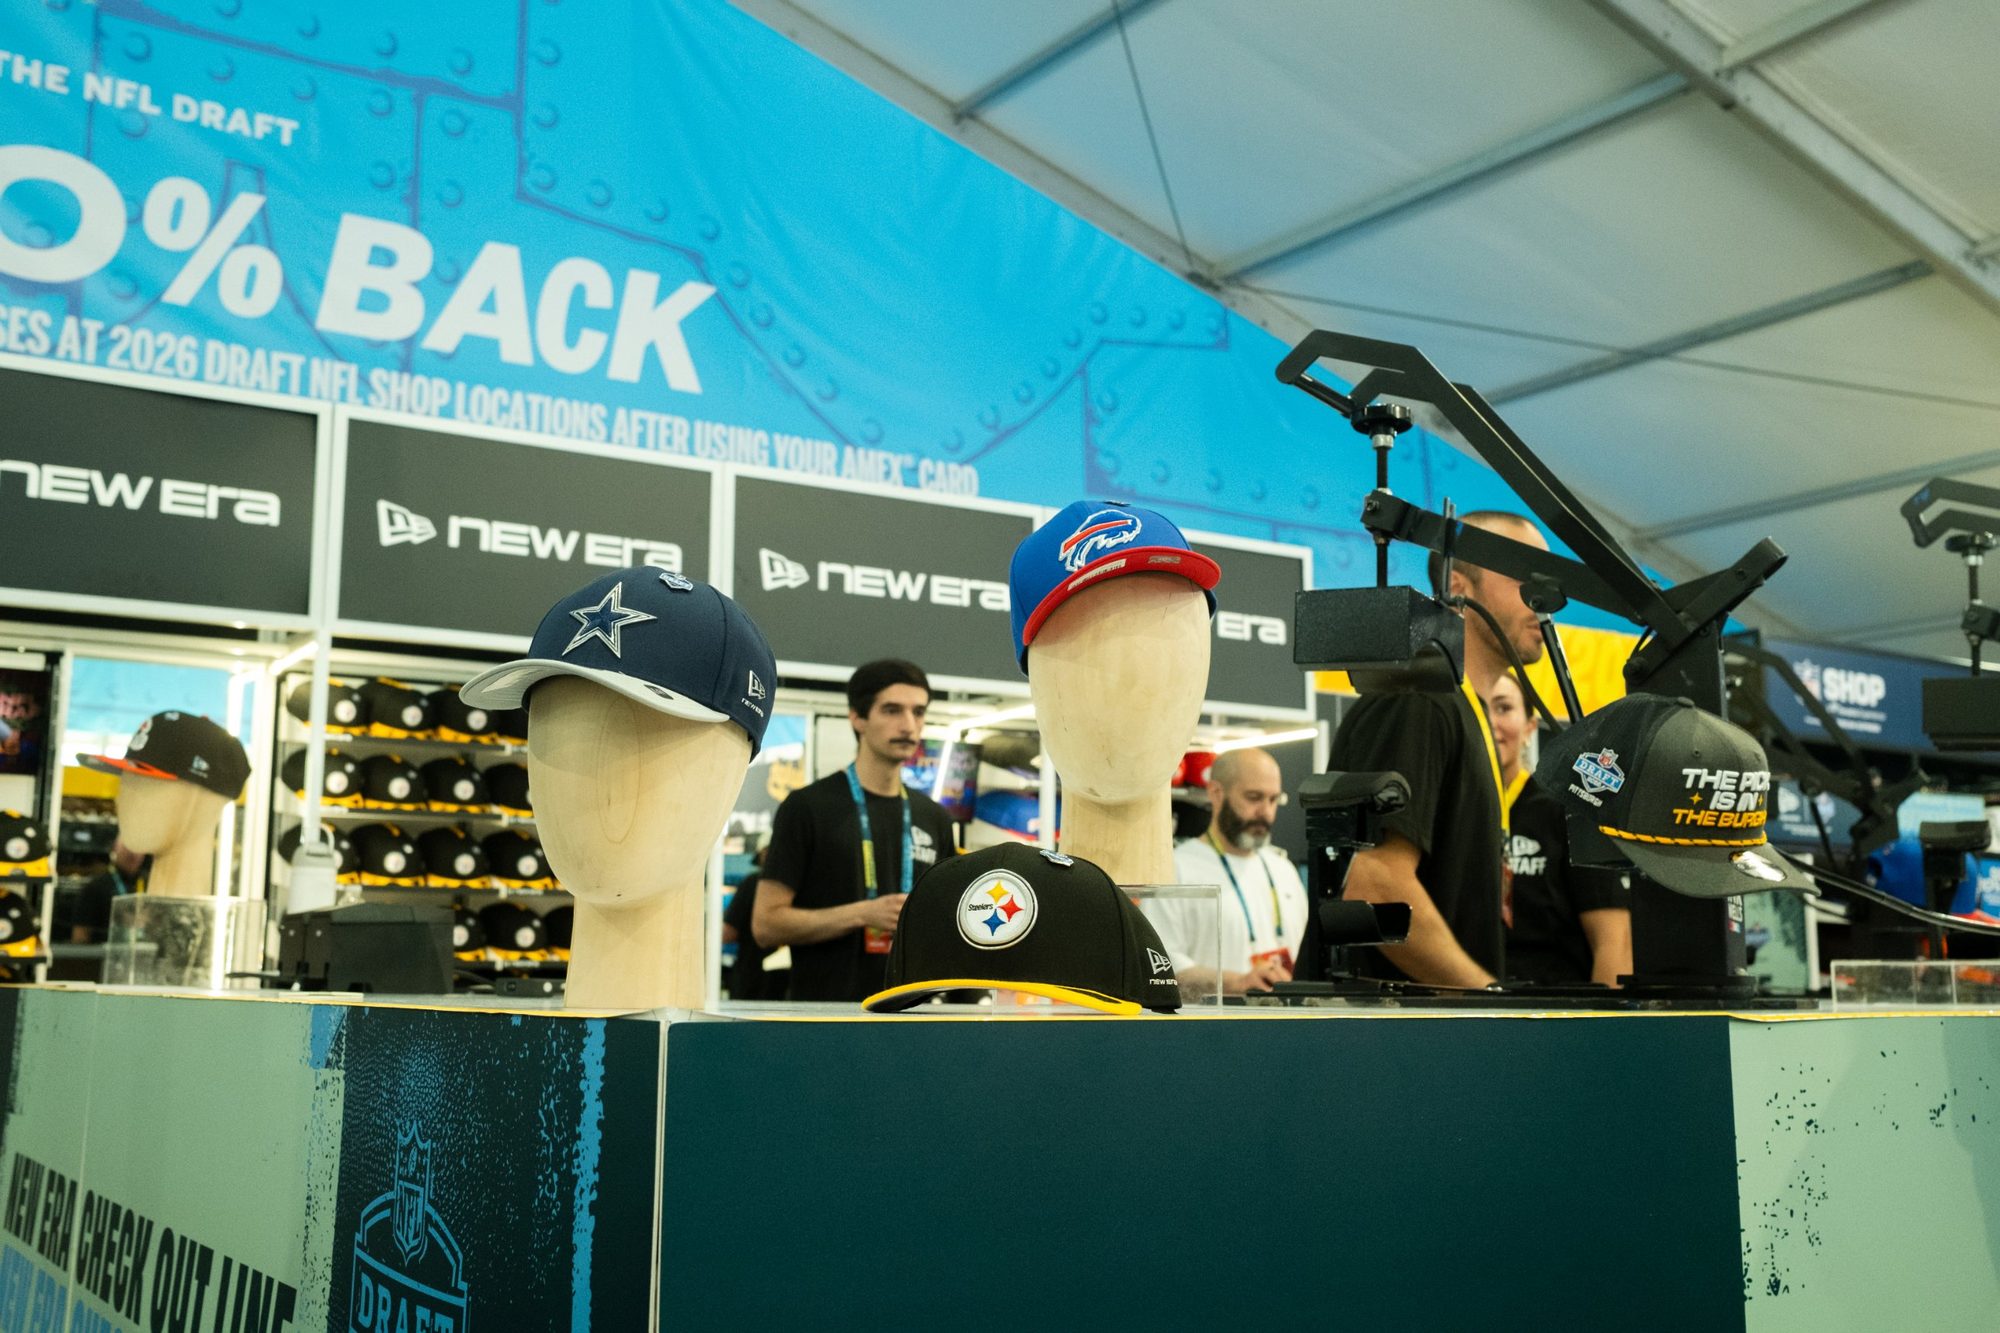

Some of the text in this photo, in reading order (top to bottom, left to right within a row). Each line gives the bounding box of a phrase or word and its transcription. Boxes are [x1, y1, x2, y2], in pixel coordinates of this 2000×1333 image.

[83, 72, 162, 116] NFL
[172, 93, 299, 147] DRAFT
[315, 213, 715, 395] BACK
[56, 314, 104, 364] AT
[106, 324, 200, 380] 2026
[203, 339, 306, 396] DRAFT
[309, 357, 363, 407] NFL
[369, 367, 452, 418] SHOP
[454, 381, 608, 443] LOCATIONS
[611, 406, 691, 458] AFTER
[694, 420, 770, 468] USING
[772, 432, 839, 478] YOUR
[918, 457, 980, 498] CARD
[1822, 666, 1887, 708] SHOP
[1578, 758, 1622, 790] DRAFT
[1682, 768, 1740, 791] THE
[1673, 808, 1720, 826] THE
[1709, 790, 1760, 813] IS IN
[1508, 856, 1548, 876] TAFF
[968, 903, 994, 912] Steelers
[4, 1152, 45, 1247] NEW
[38, 1168, 78, 1272] ERA
[76, 1189, 154, 1326] CHECK
[150, 1227, 214, 1333] OUT
